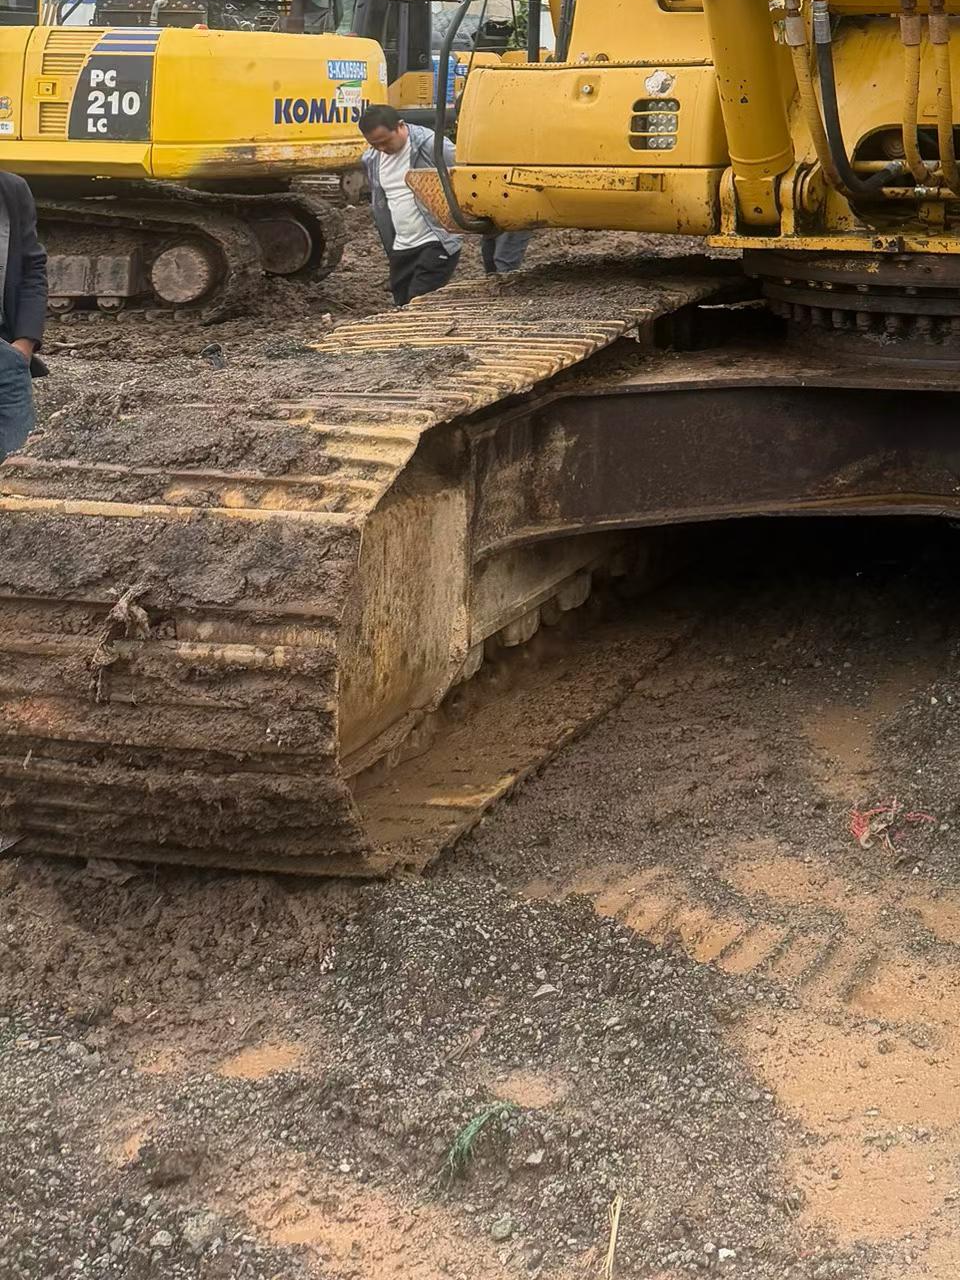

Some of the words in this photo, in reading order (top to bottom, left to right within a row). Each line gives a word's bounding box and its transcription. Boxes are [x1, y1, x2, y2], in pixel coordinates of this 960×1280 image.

[90, 69, 117, 87] PC
[87, 90, 141, 115] 210
[87, 118, 108, 133] LC
